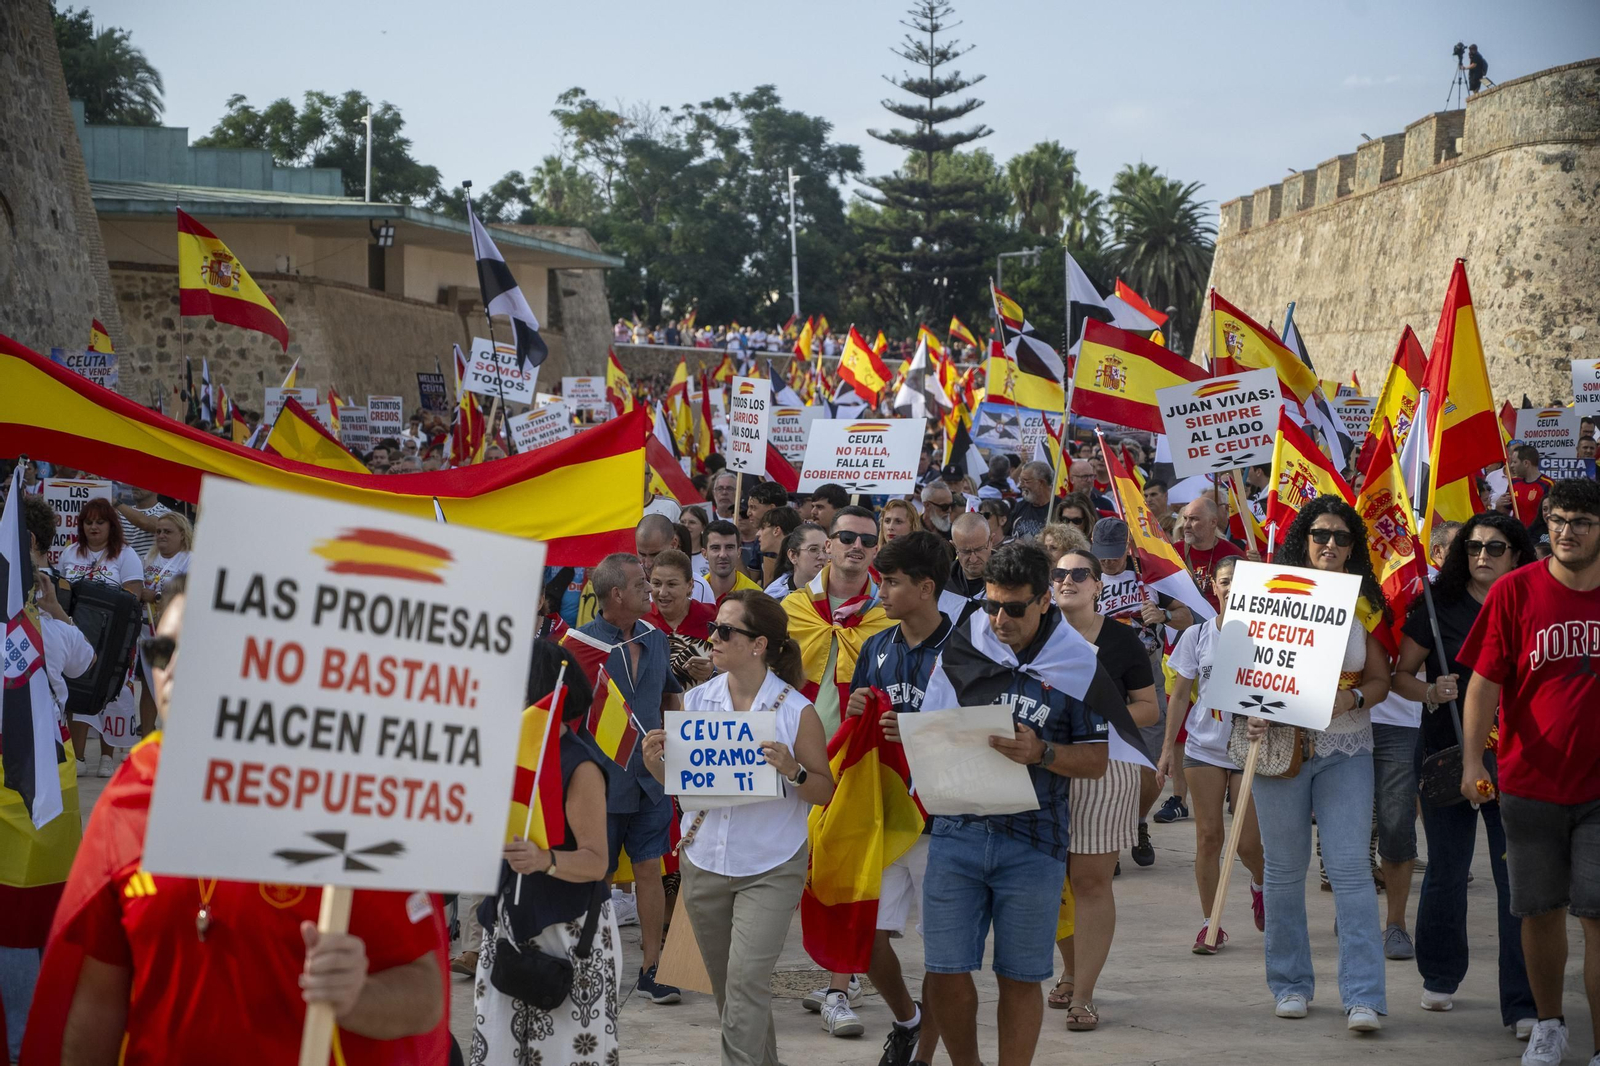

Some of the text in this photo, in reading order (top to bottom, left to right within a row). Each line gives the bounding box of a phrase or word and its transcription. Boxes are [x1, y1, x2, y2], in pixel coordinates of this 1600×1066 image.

[66, 355, 107, 368] CEUTA
[480, 351, 519, 366] CEUT
[89, 367, 111, 377] VENDE
[475, 361, 532, 381] SOMOS
[418, 374, 444, 383] MELILLA
[472, 372, 529, 393] TODOS.
[421, 383, 444, 392] CEUTA
[370, 401, 400, 410] DISTINTOS
[733, 396, 765, 411] TODOS LOS
[1166, 388, 1276, 418] JUAN VIVAS:
[1576, 395, 1588, 403] SIN
[515, 412, 562, 432] DISTINTOS
[733, 411, 759, 425] BARRIOS
[777, 417, 800, 425] CEUTA
[1185, 405, 1262, 429] SIEMPRE
[1537, 419, 1559, 427] CEUTA
[369, 426, 401, 435] UNA MISMA
[518, 436, 538, 447] UNA
[538, 425, 568, 439] MISMA
[731, 426, 760, 440] UNA SOLA
[771, 426, 805, 435] NO FALLA,
[1191, 420, 1264, 443] AL LADO
[1524, 429, 1569, 438] SOMOSTODOS
[773, 435, 793, 443] FALLA
[848, 434, 883, 444] CEUTA
[1528, 439, 1575, 449] EXCEPCIONES.
[732, 441, 753, 454] CEUTA.
[836, 447, 891, 458] NO FALLA,
[1188, 434, 1274, 459] DE CEUTA
[836, 459, 885, 468] FALLA EL
[1540, 458, 1587, 469] CEUTA
[803, 470, 914, 480] GOBIERNO CENTRAL
[1540, 470, 1588, 480] MELILLA
[69, 487, 89, 498] LAS
[1099, 580, 1139, 602] EUTA
[212, 567, 514, 656] LAS PROMESAS
[1105, 598, 1118, 611] SE
[1230, 593, 1348, 627] LA ESPAÑOLIDAD
[1247, 620, 1315, 648] DE CEUTA
[1253, 645, 1297, 669] NO SE
[240, 635, 480, 709] NO BASTAN:
[1235, 667, 1300, 696] NEGOCIA.
[886, 683, 925, 708] EUT
[1000, 693, 1051, 728] UTA
[214, 696, 482, 768] HACEN FALTA
[680, 719, 754, 742] CEUTA
[690, 748, 767, 767] ORAMOS
[680, 770, 715, 790] POR
[203, 757, 474, 826] RESPUESTAS.
